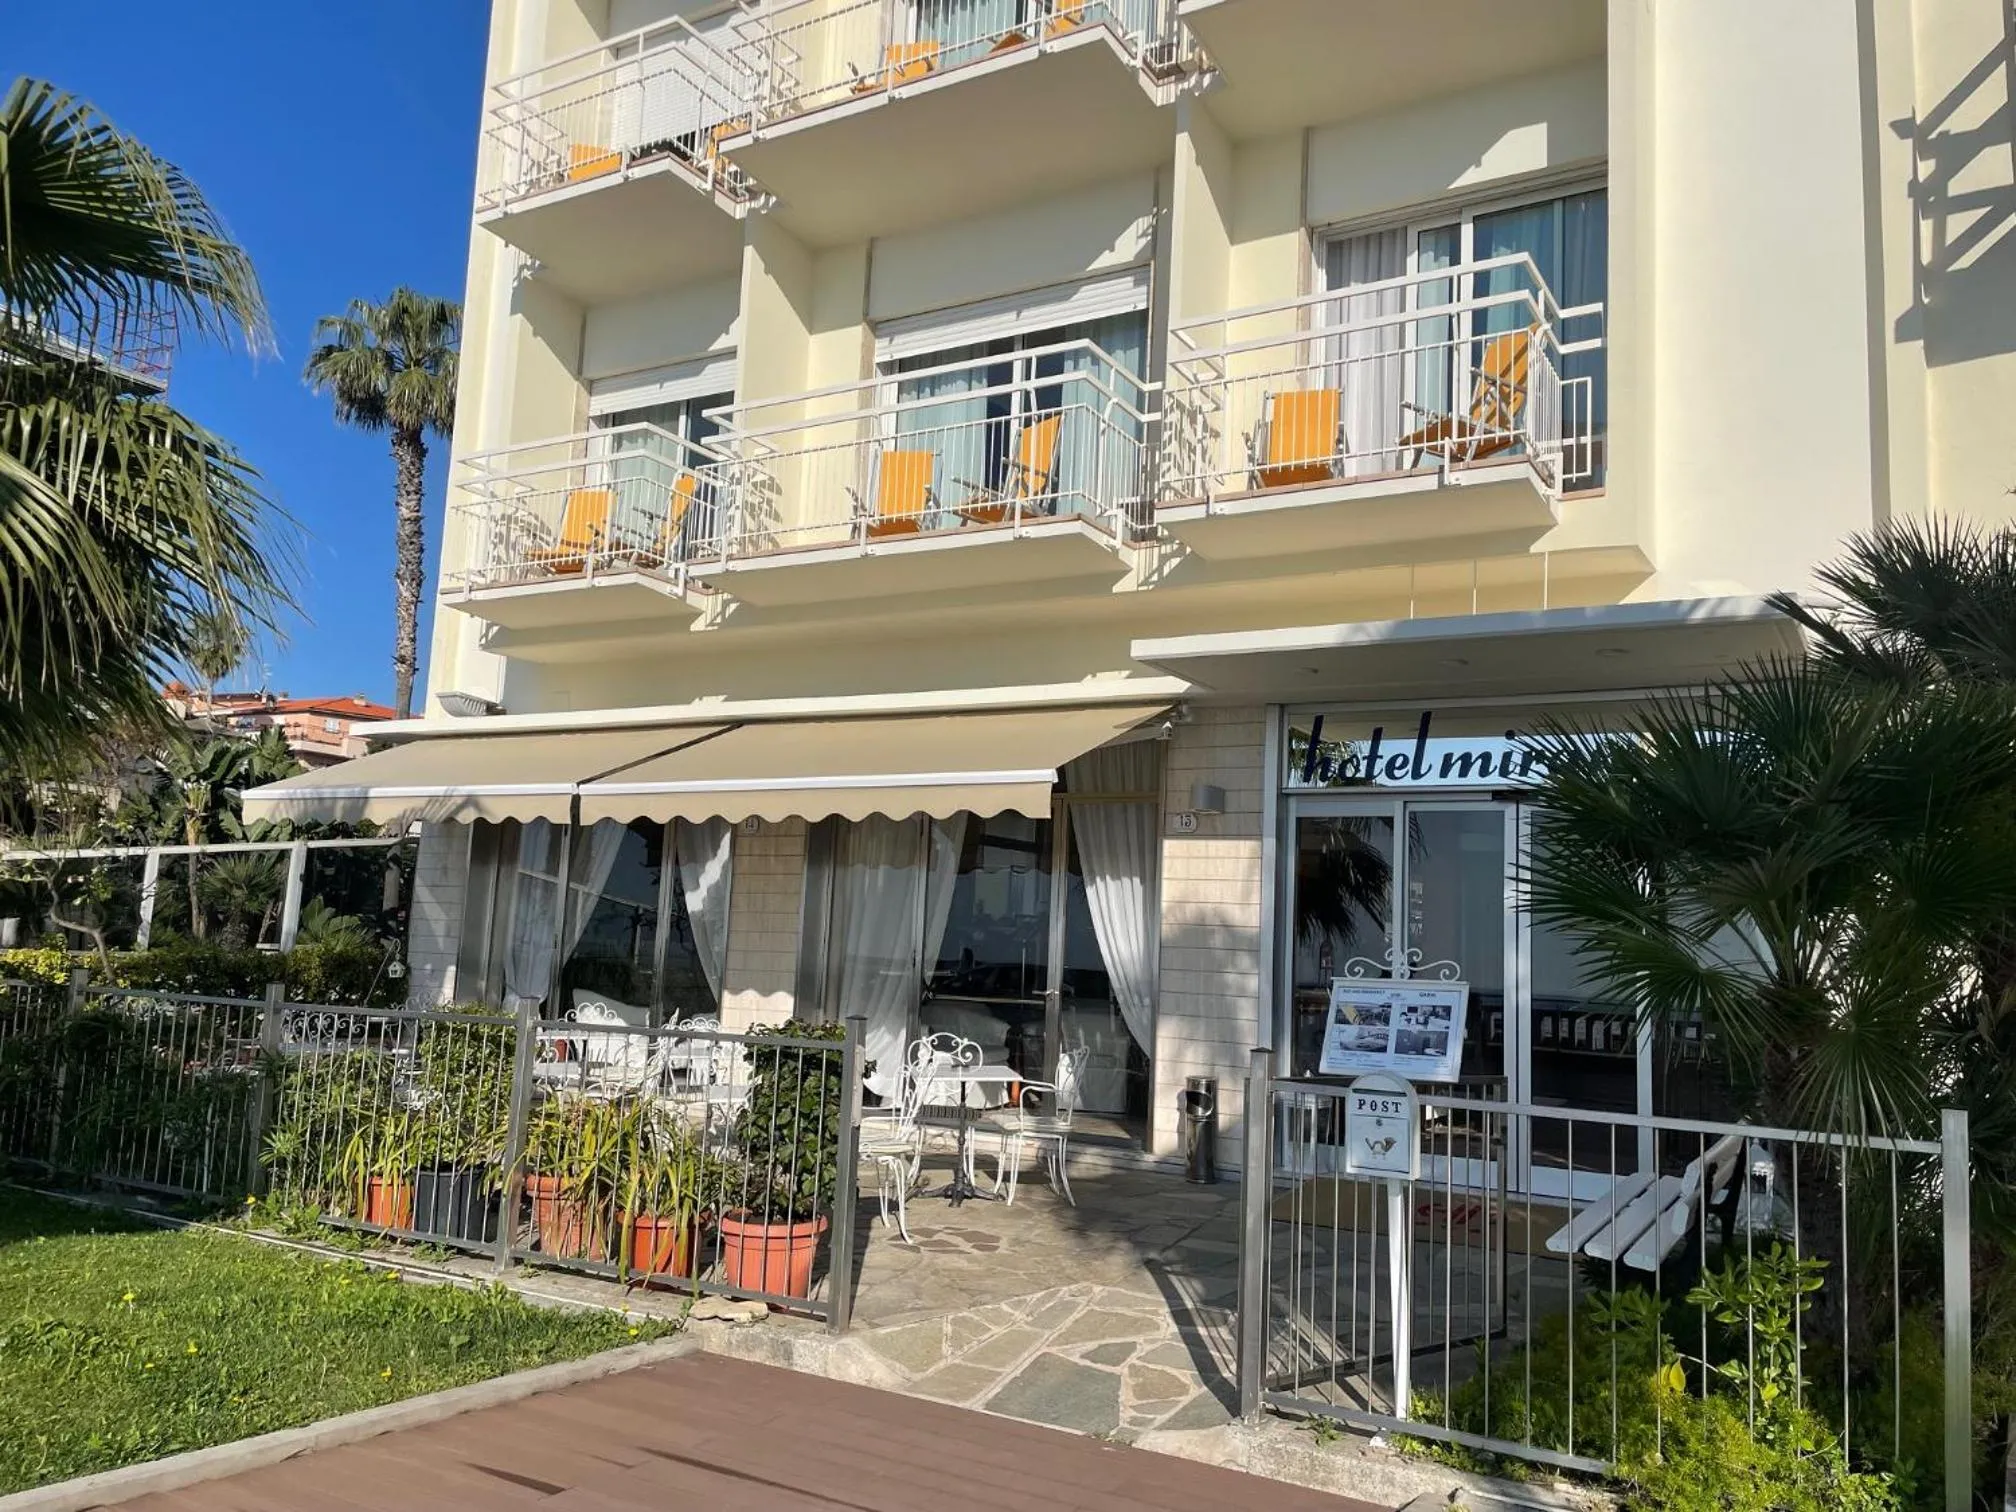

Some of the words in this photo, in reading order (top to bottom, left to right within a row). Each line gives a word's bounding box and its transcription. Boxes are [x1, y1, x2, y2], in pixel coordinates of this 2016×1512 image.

[1303, 711, 1432, 783] hotel
[1440, 730, 1548, 779] mir
[1358, 1098, 1402, 1113] POST
